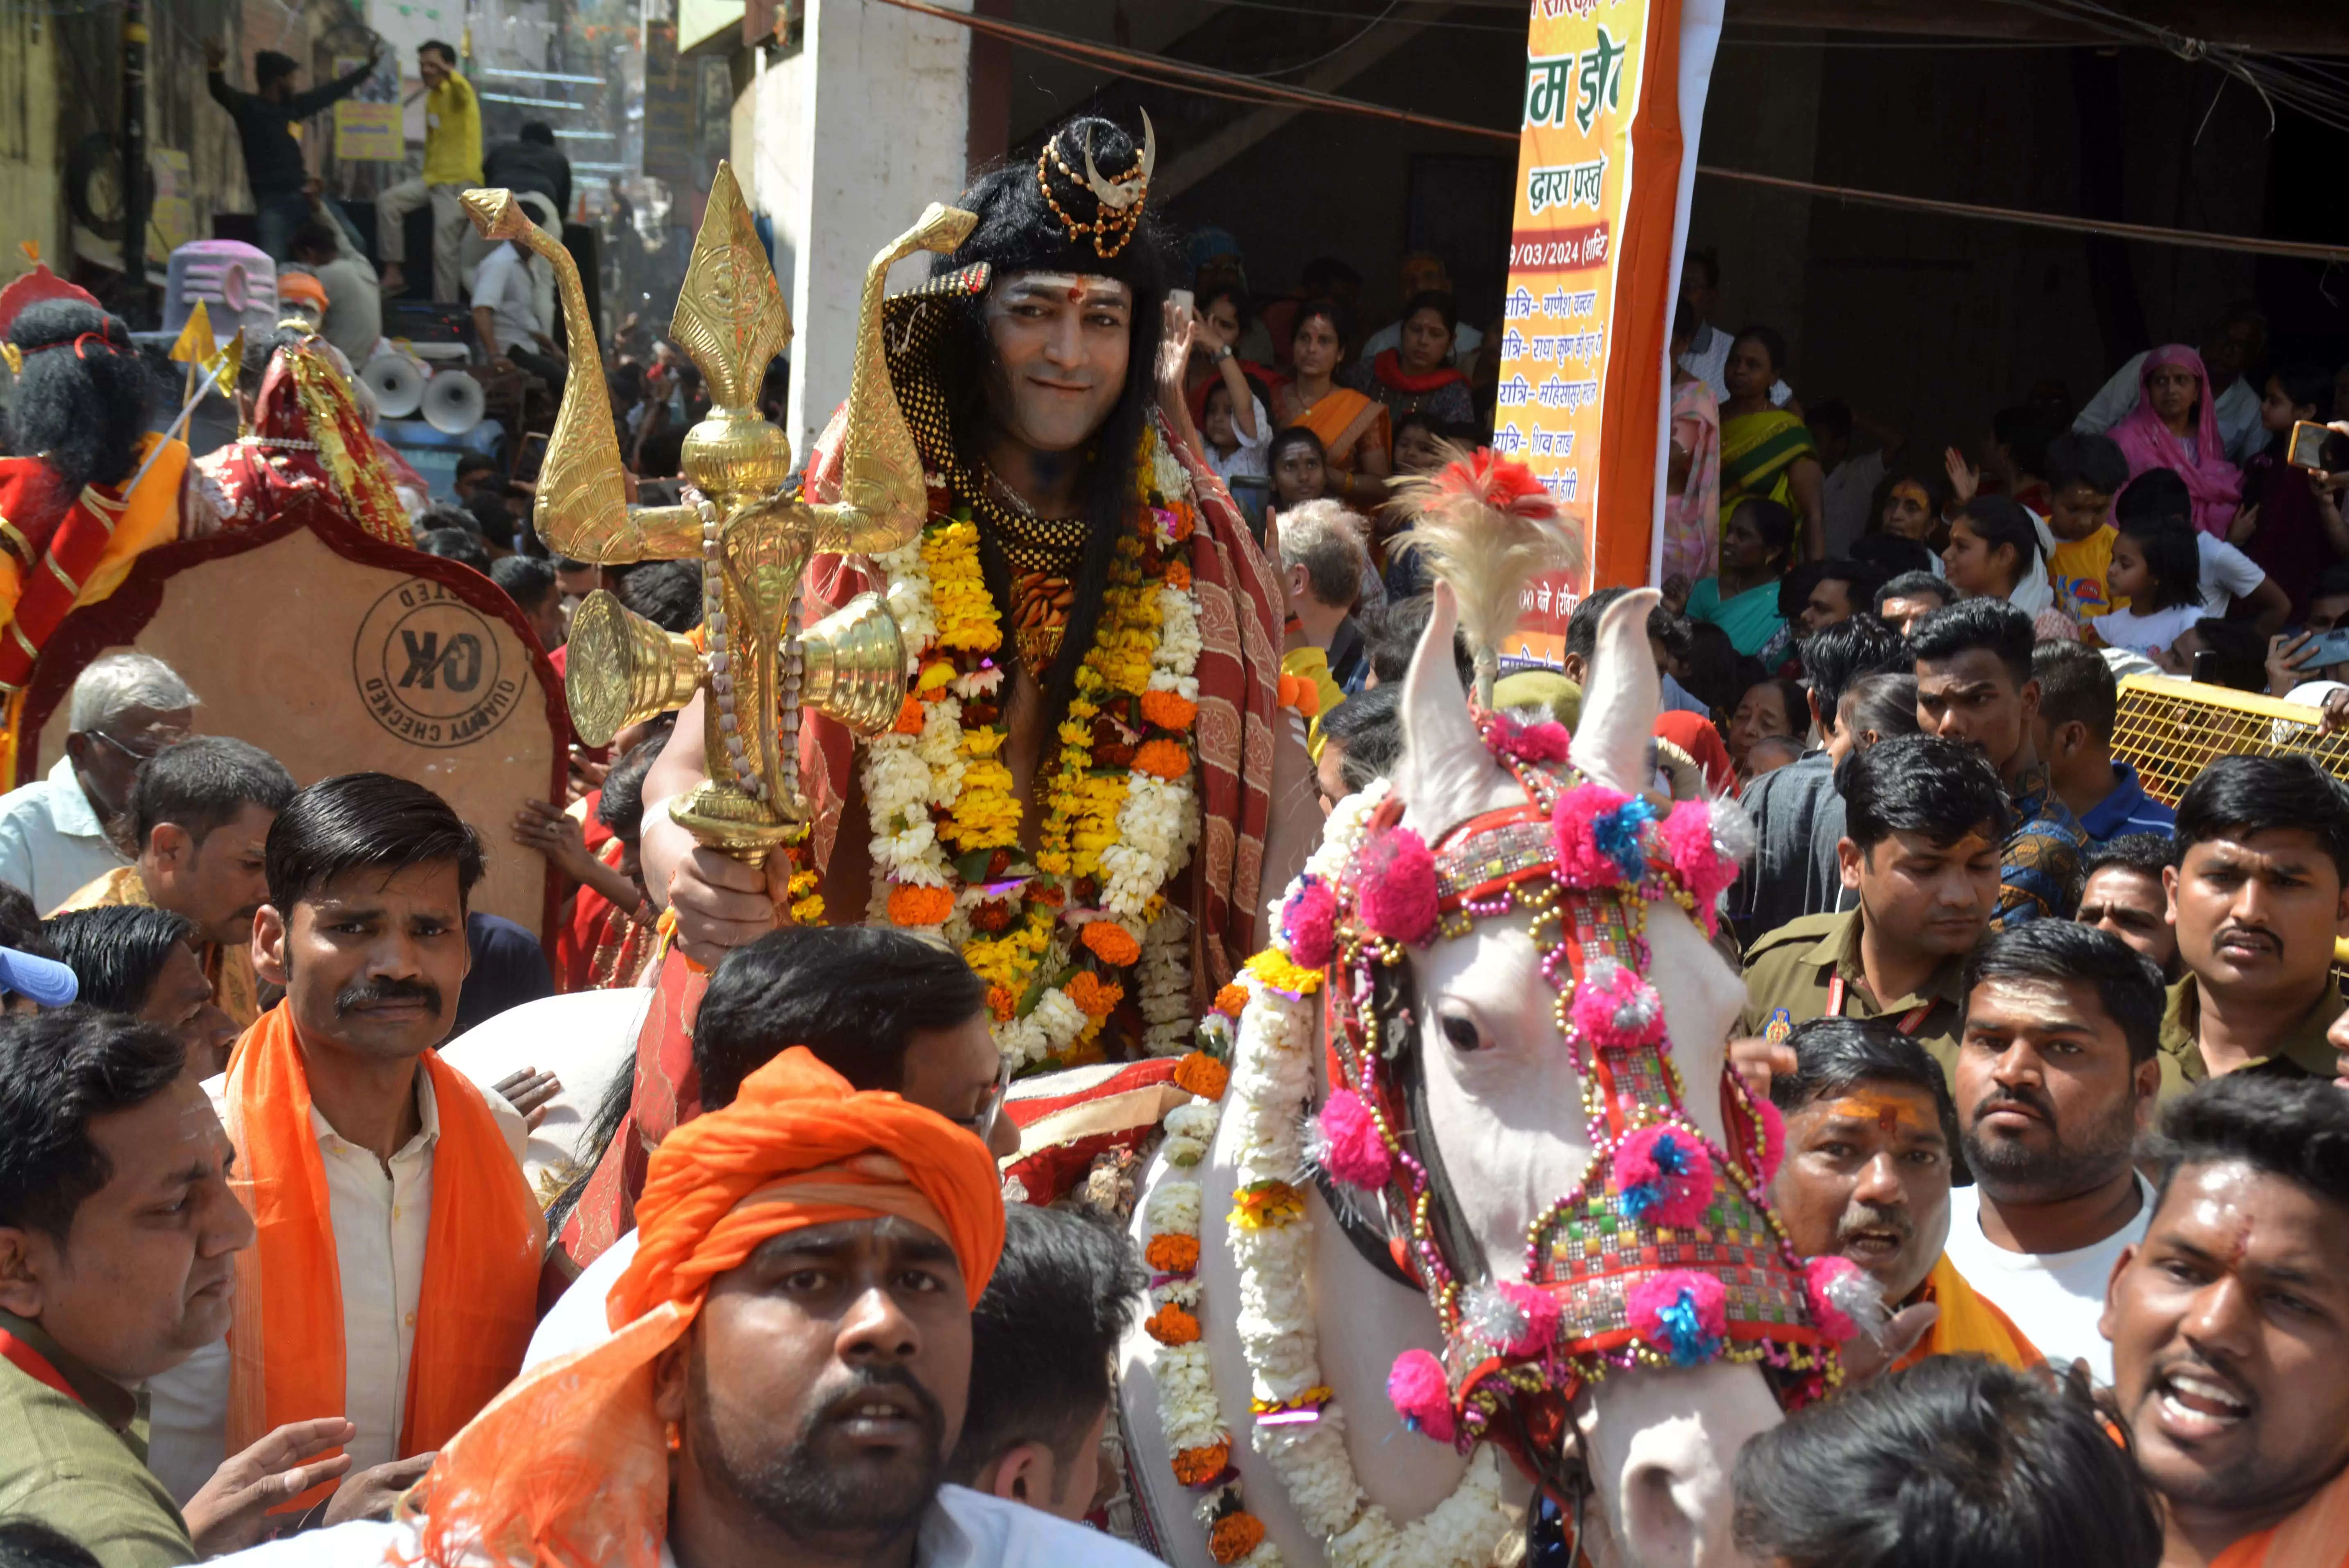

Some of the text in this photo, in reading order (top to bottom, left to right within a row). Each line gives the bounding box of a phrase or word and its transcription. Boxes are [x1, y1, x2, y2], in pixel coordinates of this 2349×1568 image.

[1544, 287, 1571, 316] गणेश
[1533, 339, 1554, 358] राधा
[1557, 338, 1574, 366] कृष्ण
[1539, 376, 1581, 413] महिसासुर
[1532, 425, 1553, 453] शिव
[398, 630, 482, 692] OK
[365, 677, 441, 741] CHECKED
